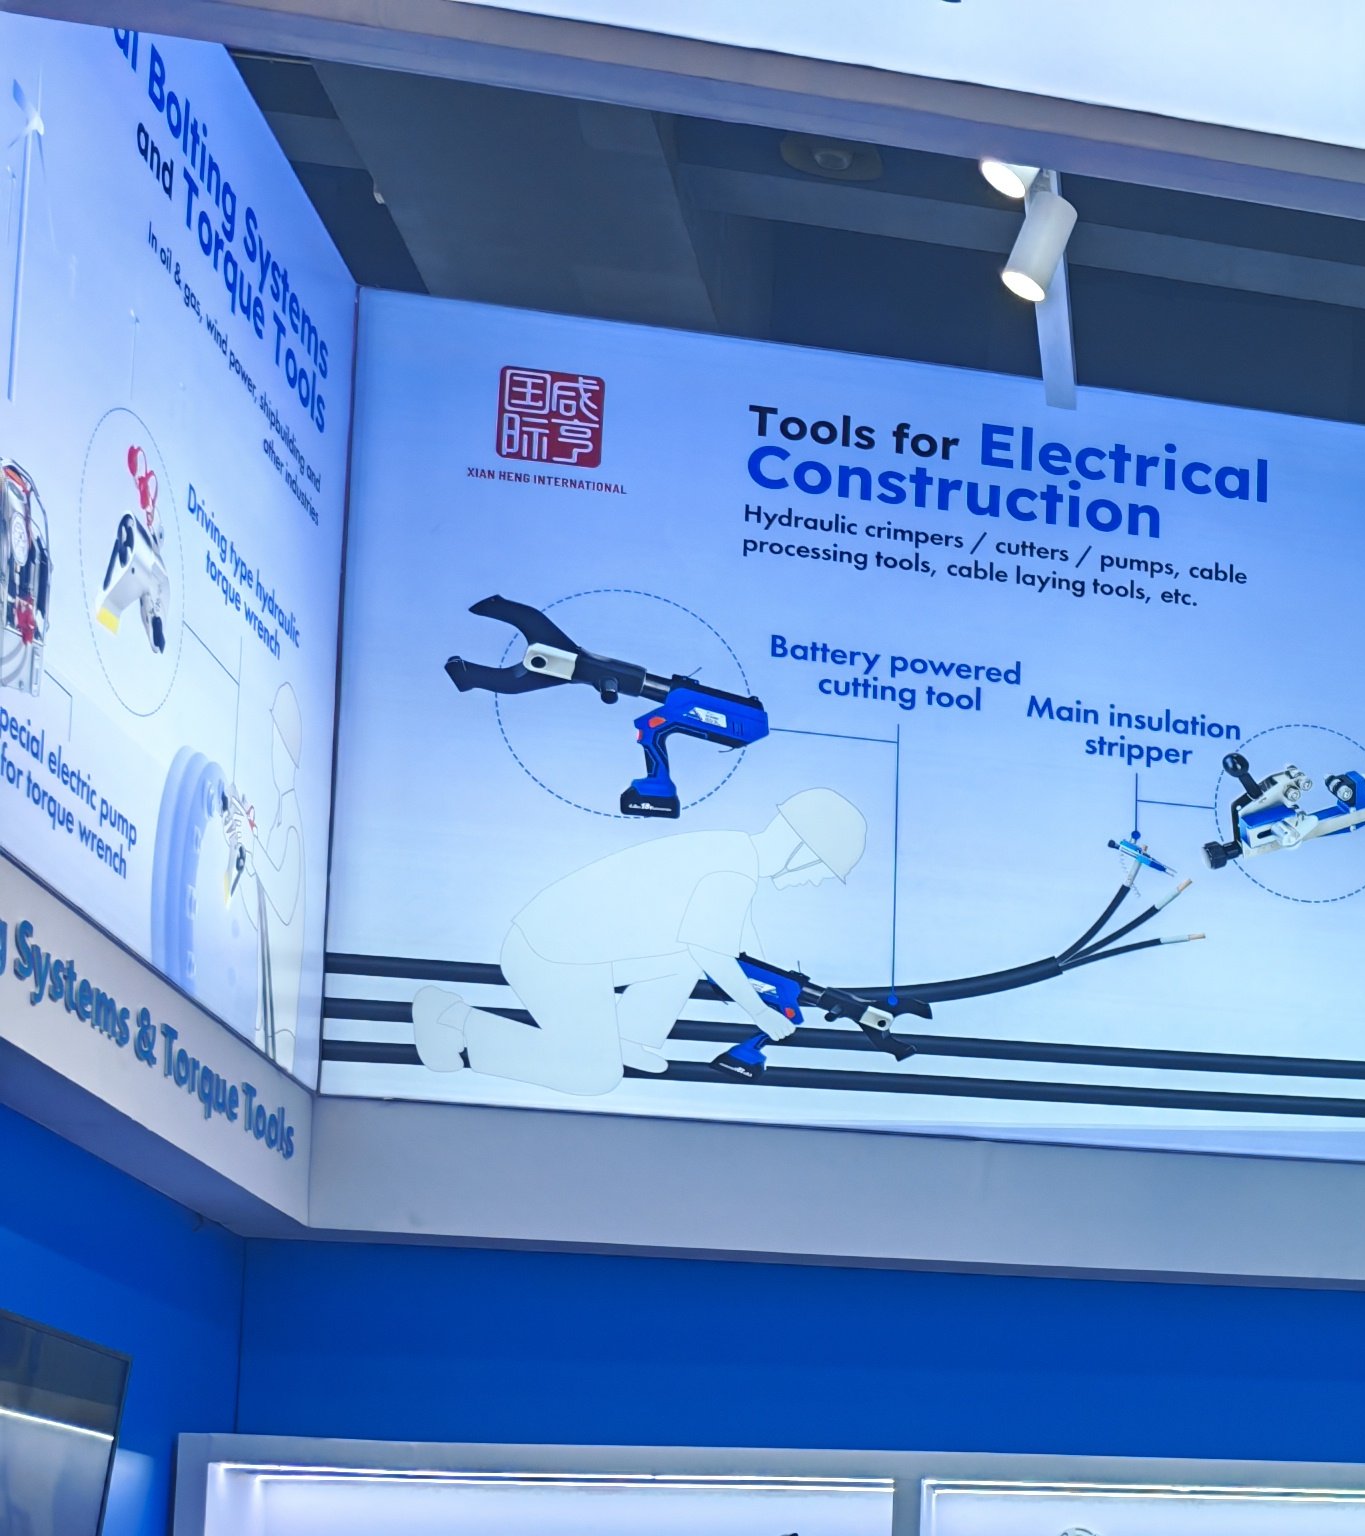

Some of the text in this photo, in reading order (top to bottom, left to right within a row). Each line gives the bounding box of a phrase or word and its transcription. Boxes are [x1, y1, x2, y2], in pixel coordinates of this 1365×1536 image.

[148, 43, 237, 242] Bolting
[243, 207, 329, 379] Systems
[137, 122, 326, 433] and Torque Tools
[148, 221, 158, 253] In
[160, 247, 172, 274] oil
[174, 262, 182, 291] &
[206, 313, 228, 356] wind
[229, 349, 258, 404] power,
[259, 391, 305, 477] shipbuilding
[306, 462, 321, 493] and
[262, 437, 319, 526] other industries
[467, 467, 628, 495] XIAN HENG INTERNATIONAL
[747, 445, 1161, 539] Construction
[749, 404, 1268, 504] Tools for Electrical
[188, 483, 300, 649] Driving type hydraulic
[742, 537, 1198, 607] processing tools, cable laying tools, etc.
[744, 504, 858, 536] Hydraulic
[865, 521, 964, 549] crimpers
[995, 540, 1070, 563] cutters
[1100, 553, 1181, 580] pumps,
[1188, 561, 1248, 585] cable
[206, 550, 281, 660] torque wrench
[770, 634, 1023, 687] Battery powered
[818, 677, 982, 712] cutting tool
[1026, 695, 1242, 741] Main insulation
[1084, 734, 1194, 769] stripper
[0, 742, 127, 879] for torque wrench
[48, 745, 97, 811] electric
[99, 797, 138, 851] pump
[14, 919, 131, 1047] Systems
[134, 1007, 157, 1067] &
[161, 1023, 239, 1122] Torque
[241, 1082, 295, 1160] Tools
